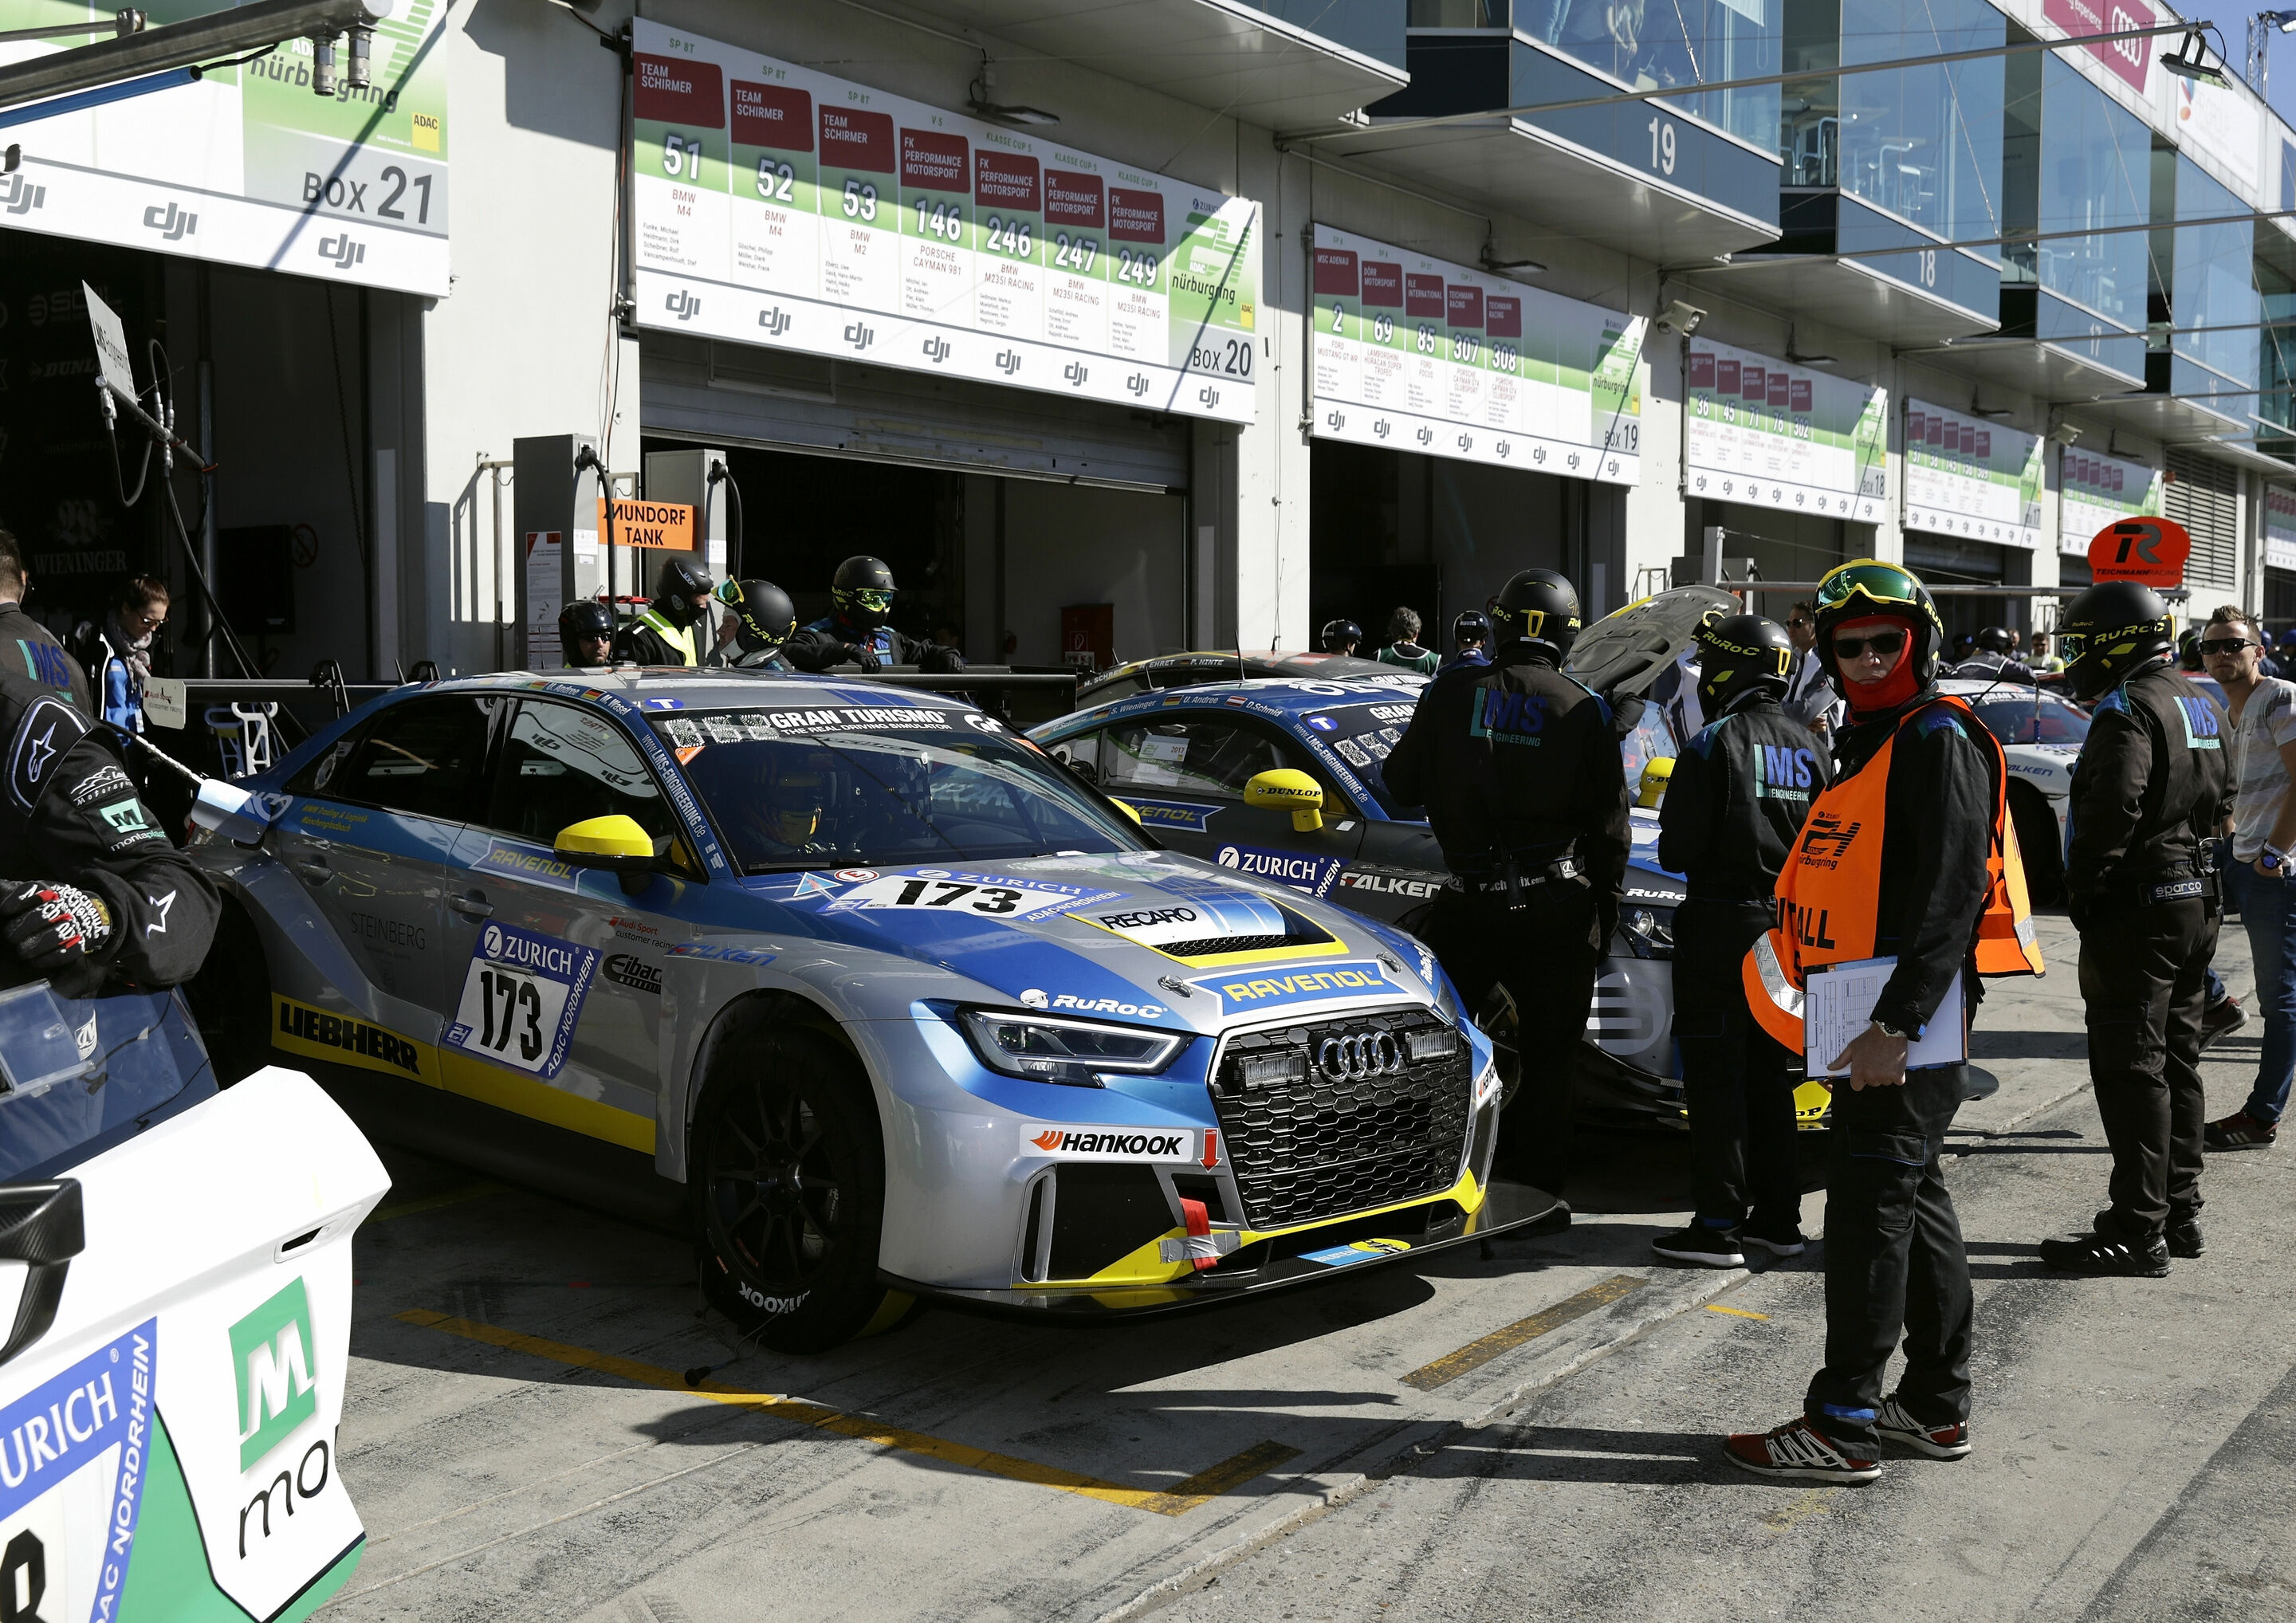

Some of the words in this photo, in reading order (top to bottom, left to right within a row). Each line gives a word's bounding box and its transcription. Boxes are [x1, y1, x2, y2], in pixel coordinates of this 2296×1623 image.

[670, 38, 681, 49] SP
[683, 41, 694, 53] 8T
[641, 62, 668, 77] TEAM
[763, 65, 773, 76] SP
[775, 69, 785, 80] 8T
[642, 76, 692, 94] SCHIRMER
[736, 89, 761, 104] TEAM
[414, 115, 438, 130] ADAC
[737, 104, 784, 121] SCHIRMER
[904, 136, 914, 148] FK
[986, 132, 1010, 147] KLASSE
[1012, 137, 1025, 151] CUP
[1027, 142, 1032, 153] 5
[1648, 116, 1677, 176] 19
[663, 135, 700, 180] 51
[905, 150, 961, 167] PERFORMANCE
[979, 158, 989, 169] FK
[757, 159, 794, 202] 52
[906, 163, 958, 179] MOTORSPORT
[980, 170, 1033, 188] PERFORMANCE
[981, 182, 1030, 198] MOTORSPORT
[1048, 177, 1056, 188] FK
[302, 171, 368, 213] BOX
[377, 165, 433, 225] 21
[672, 190, 697, 203] BMW
[843, 180, 876, 222] 53
[1048, 189, 1098, 206] PERFORMANCE
[677, 203, 691, 218] M4
[765, 210, 787, 224] BMW
[1048, 201, 1095, 216] MOTORSPORT
[1199, 201, 1221, 214] ZURICH
[769, 223, 782, 238] M4
[915, 198, 962, 242] 146
[850, 230, 871, 243] BMW
[986, 215, 1032, 258] 246
[854, 242, 867, 255] M2
[920, 245, 956, 263] PORSCHE
[1055, 234, 1098, 273] 247
[913, 257, 947, 273] CAYMAN
[949, 265, 961, 277] 981
[1001, 263, 1019, 276] BMW
[1118, 250, 1158, 288] 249
[1189, 261, 1206, 274] ADAC
[1318, 255, 1328, 264] MSC
[1329, 256, 1349, 265] ADENAU
[1917, 248, 1936, 289] 18
[1008, 277, 1034, 292] RACING
[1067, 278, 1085, 291] BMW
[1172, 273, 1236, 305] nürburgring
[1364, 278, 1396, 288] MOTORSPORT
[1075, 291, 1099, 306] RACING
[1408, 290, 1442, 300] INTERNATIONAL
[1241, 305, 1252, 313] ADAC
[1332, 304, 1343, 332] 2
[1374, 314, 1394, 343] 69
[1417, 325, 1435, 353] 85
[1331, 340, 1344, 349] FORD
[1453, 334, 1480, 363] 307
[1193, 347, 1221, 372] BOX
[1225, 339, 1252, 377] 20
[1492, 342, 1516, 373] 308
[1593, 377, 1629, 397] nürburgring
[1696, 392, 1709, 417] 36
[1723, 399, 1736, 423] 45
[1749, 404, 1759, 429] 71
[1772, 411, 1784, 434] 76
[1604, 430, 1620, 447] BOX
[1624, 424, 1638, 450] 19
[1793, 417, 1809, 439] 302
[1875, 474, 1885, 495] 18
[603, 504, 686, 525] MUNDORF
[625, 527, 664, 546] TANK
[1702, 631, 1760, 656] RuRoC
[2094, 622, 2165, 645] RuRoC
[556, 684, 580, 696] Andree
[149, 702, 168, 711] customer
[170, 705, 183, 715] racing
[600, 694, 608, 703] M.
[610, 698, 631, 716] Wasel
[1119, 699, 1156, 713] Wieninger
[1470, 687, 1547, 737] LMS
[769, 709, 842, 729] GRAN
[840, 709, 945, 723] TURISMO
[801, 725, 841, 735] REAL
[842, 723, 888, 732] DRIVING
[2172, 696, 2218, 749] LMS
[1486, 729, 1541, 747] ENGINEERING
[1293, 723, 1368, 804] www.LMS-ENGINEERING.de
[1754, 744, 1814, 797] LMS
[640, 734, 706, 838] www.LMS-ENGINEERING.de
[1266, 788, 1320, 797] DUNLOP
[110, 830, 167, 851] montaplast
[489, 848, 572, 879] RAVENOL
[1244, 853, 1317, 881] ZURICH
[956, 874, 1083, 895] ZURICH
[2156, 881, 2203, 895] sparco
[895, 879, 1022, 914] 173
[618, 917, 636, 930] Audi
[637, 923, 659, 936] Sport
[1098, 906, 1197, 931] RECARO
[350, 911, 426, 950] STEINBERG
[615, 929, 650, 945] customer
[652, 937, 676, 950] racing
[506, 935, 572, 975] ZURICH
[1221, 969, 1384, 1003] RAVENOL
[480, 971, 543, 1062] 173
[547, 1033, 567, 1077] ADAC
[561, 950, 596, 1040] NORDRHEIN
[1052, 993, 1164, 1019] RuRoC
[280, 1001, 421, 1076] LIEBHERR
[0, 1371, 118, 1488] URICH
[113, 1333, 149, 1555] NORDRHEIN
